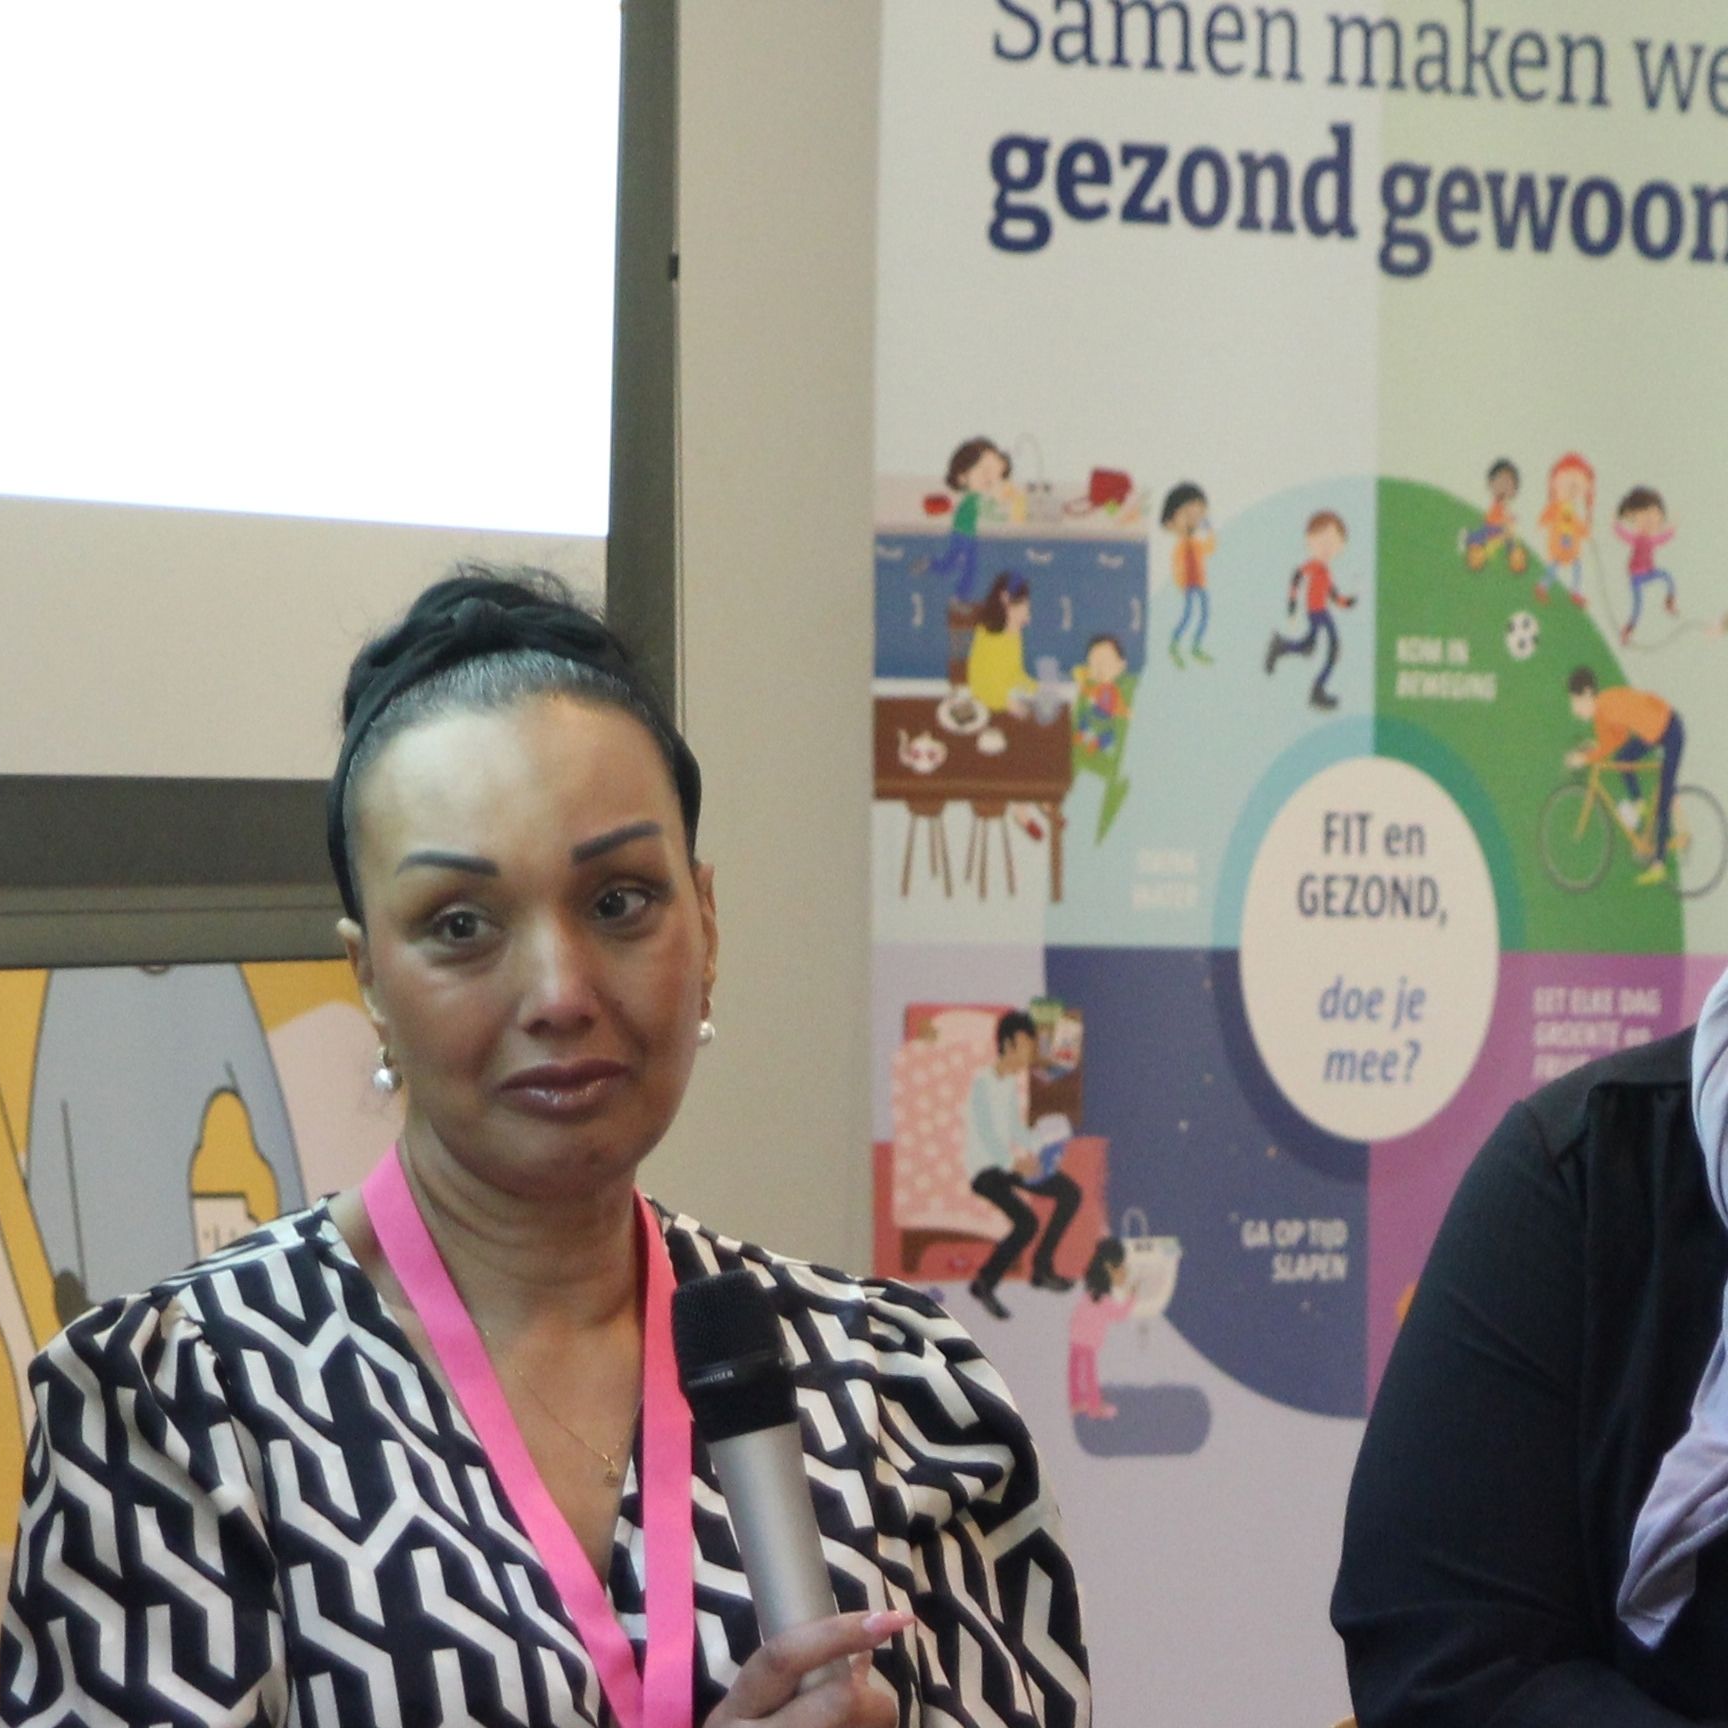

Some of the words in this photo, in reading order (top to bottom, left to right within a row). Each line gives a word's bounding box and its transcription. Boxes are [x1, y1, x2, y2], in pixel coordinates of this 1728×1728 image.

[991, 0, 1302, 83] Samen
[1326, 0, 1612, 109] maken
[987, 122, 1358, 254] gezond
[1323, 810, 1372, 856] FIT
[1383, 822, 1425, 856] en
[1297, 872, 1447, 927] GEZOND,
[1318, 975, 1384, 1022] doe
[1391, 975, 1426, 1030] je
[1323, 1040, 1422, 1084] mee?
[1241, 1219, 1271, 1248] GA
[1273, 1218, 1305, 1247] OP
[1272, 1252, 1348, 1282] SLAPEN
